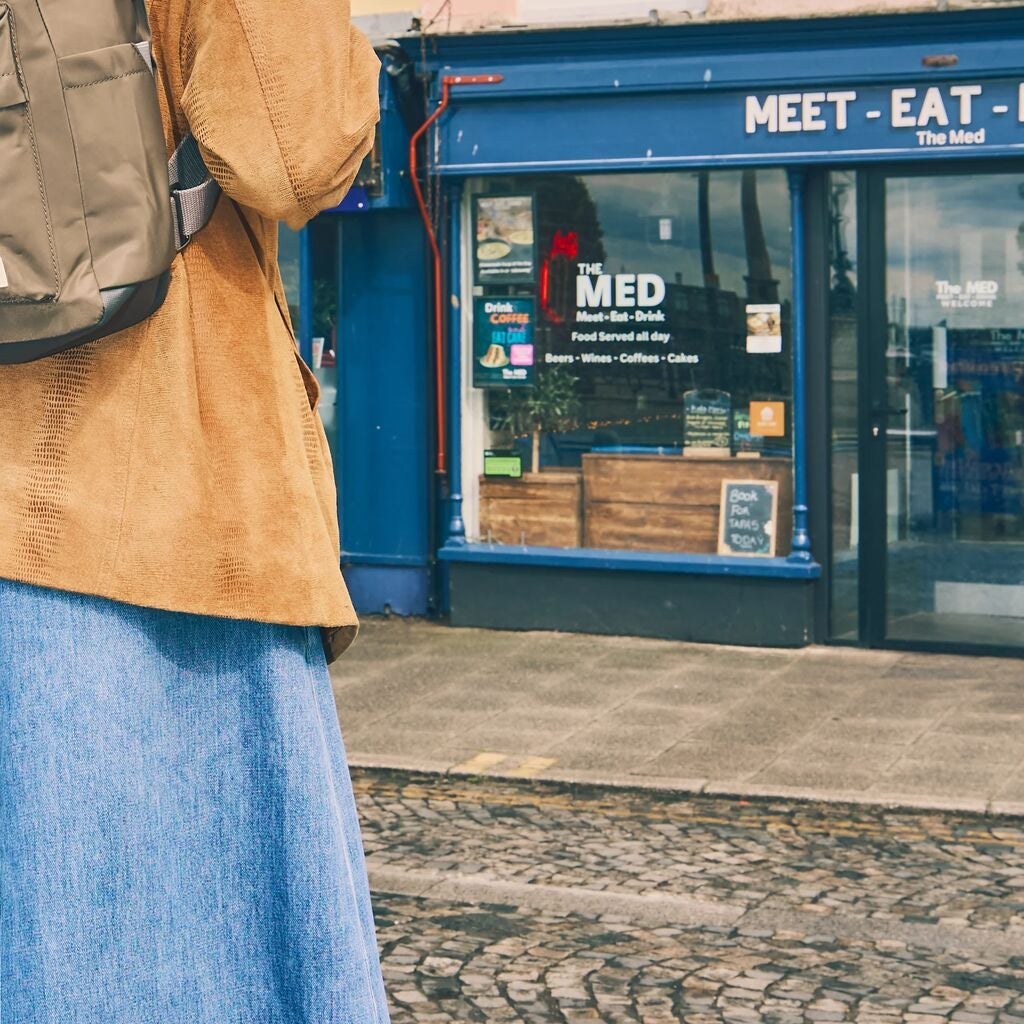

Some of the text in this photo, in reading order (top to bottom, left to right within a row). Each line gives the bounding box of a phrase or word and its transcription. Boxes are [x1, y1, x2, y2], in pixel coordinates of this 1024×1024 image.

[746, 91, 856, 133] MEET
[891, 85, 982, 128] EAT
[916, 128, 985, 146] The Med
[577, 262, 603, 275] THE
[576, 273, 666, 307] MED
[936, 280, 999, 294] The MED
[484, 302, 513, 313] Drink
[609, 311, 629, 322] Eat
[635, 310, 665, 322] Drink
[571, 331, 670, 343] Food Served all day
[545, 352, 699, 364] Beers Wines Coffees Cakes
[731, 533, 764, 546] TODAY
